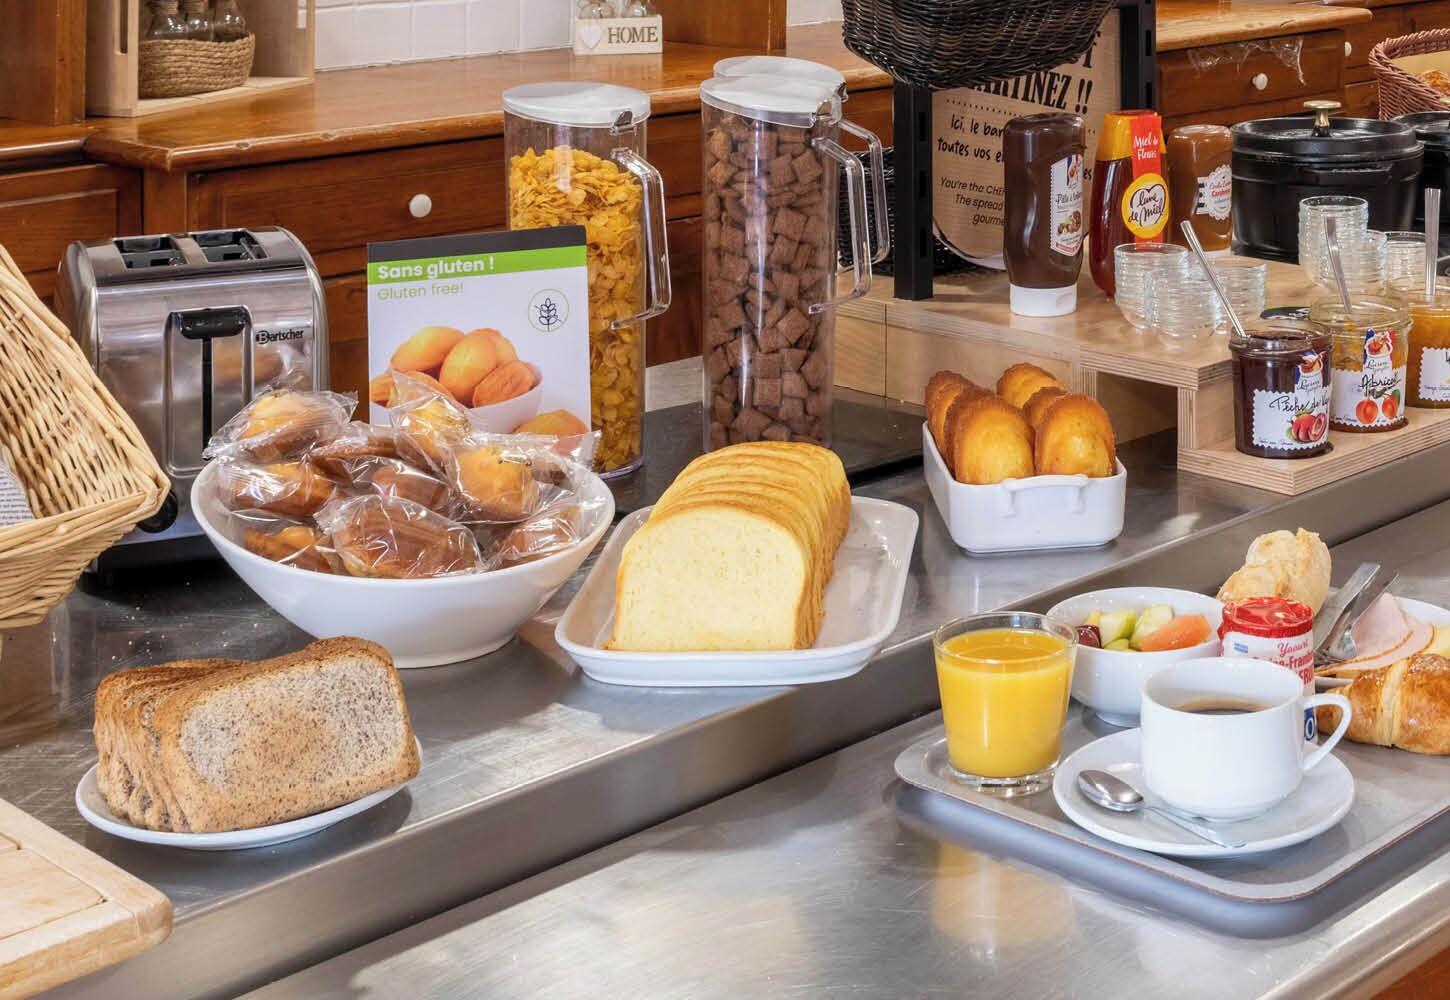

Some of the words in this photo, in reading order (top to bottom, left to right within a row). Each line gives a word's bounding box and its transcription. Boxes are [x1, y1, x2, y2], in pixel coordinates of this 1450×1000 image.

[607, 26, 659, 44] HOME
[970, 117, 979, 135] le
[938, 136, 969, 157] toutes
[974, 148, 991, 161] vos
[955, 194, 971, 206] The
[377, 264, 423, 280] Sans
[427, 260, 485, 279] gluten
[489, 255, 495, 270] !
[377, 286, 426, 300] Gluten
[431, 282, 463, 296] free!
[255, 328, 304, 345] Bartscher
